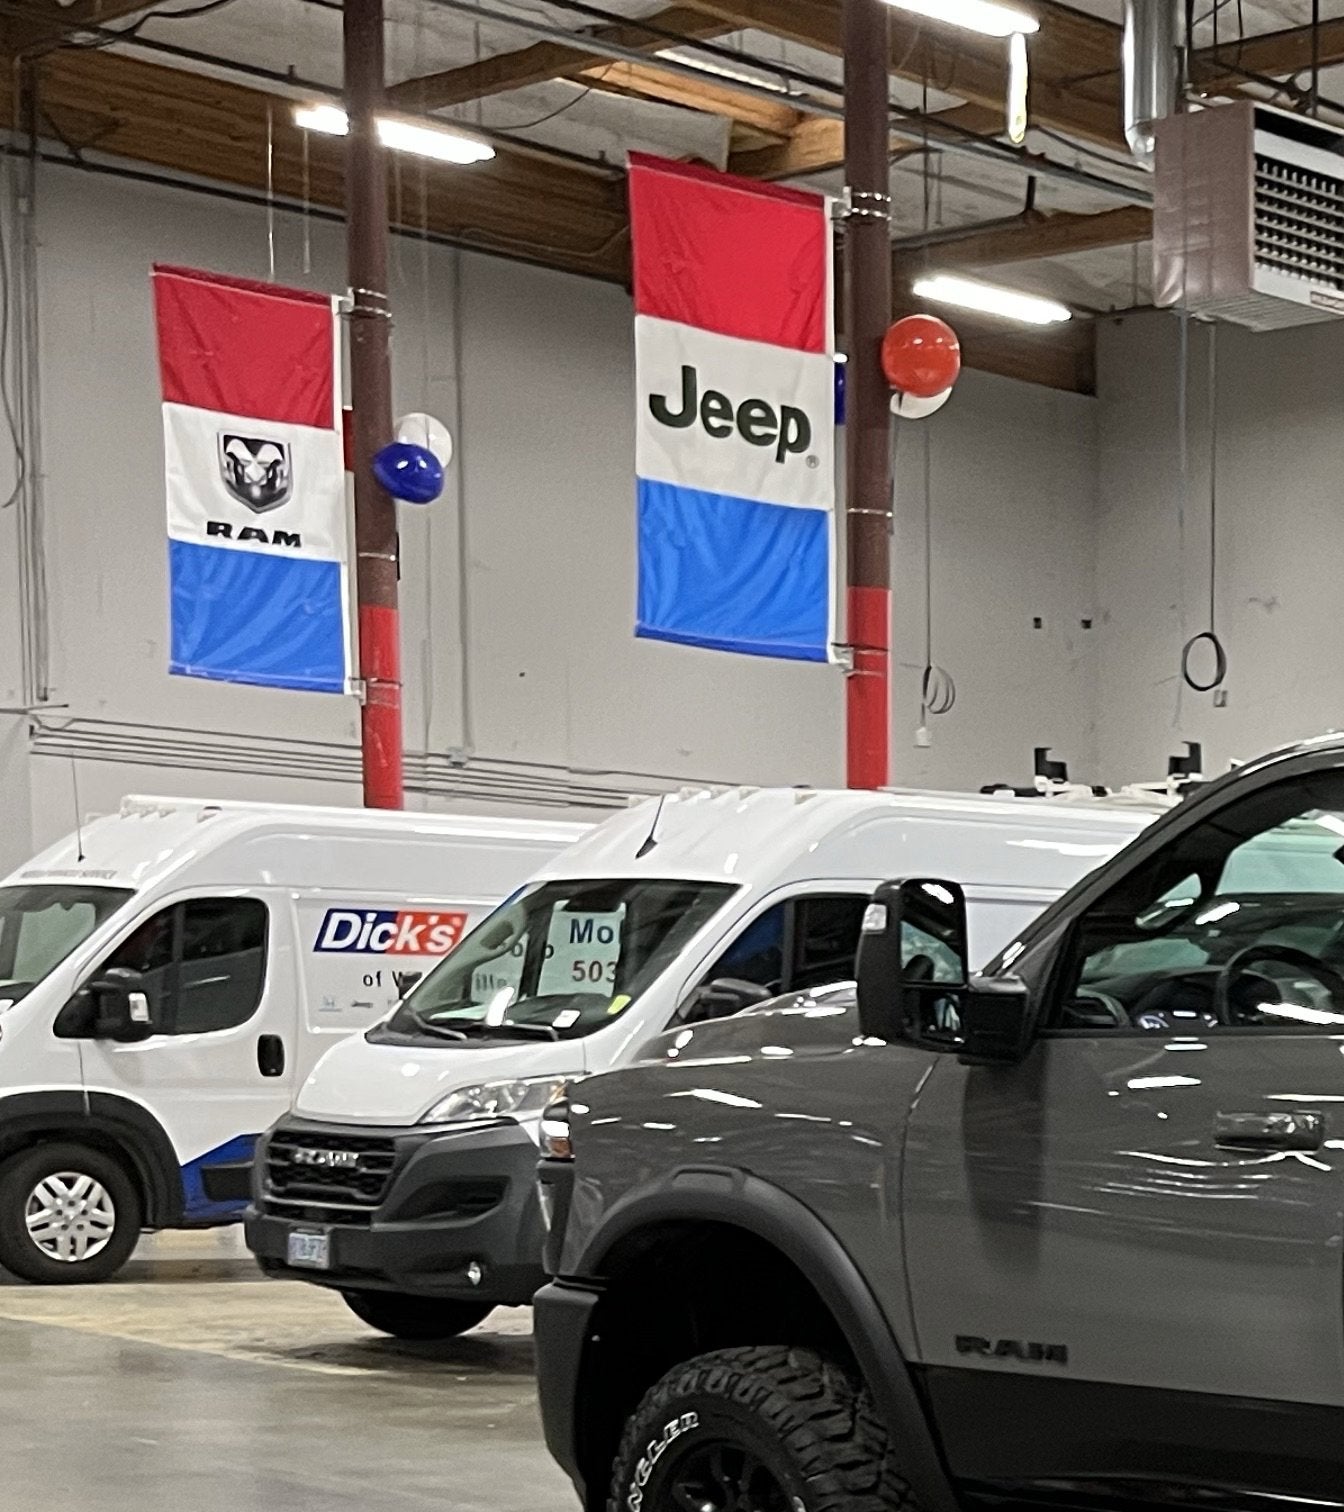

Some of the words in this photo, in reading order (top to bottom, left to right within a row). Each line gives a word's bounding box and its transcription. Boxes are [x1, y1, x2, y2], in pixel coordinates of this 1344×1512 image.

[648, 365, 811, 464] Jeep
[206, 520, 301, 548] RAM
[321, 911, 455, 951] Dick's
[569, 918, 624, 944] Mo
[362, 970, 382, 987] of
[956, 1335, 1067, 1364] RAM
